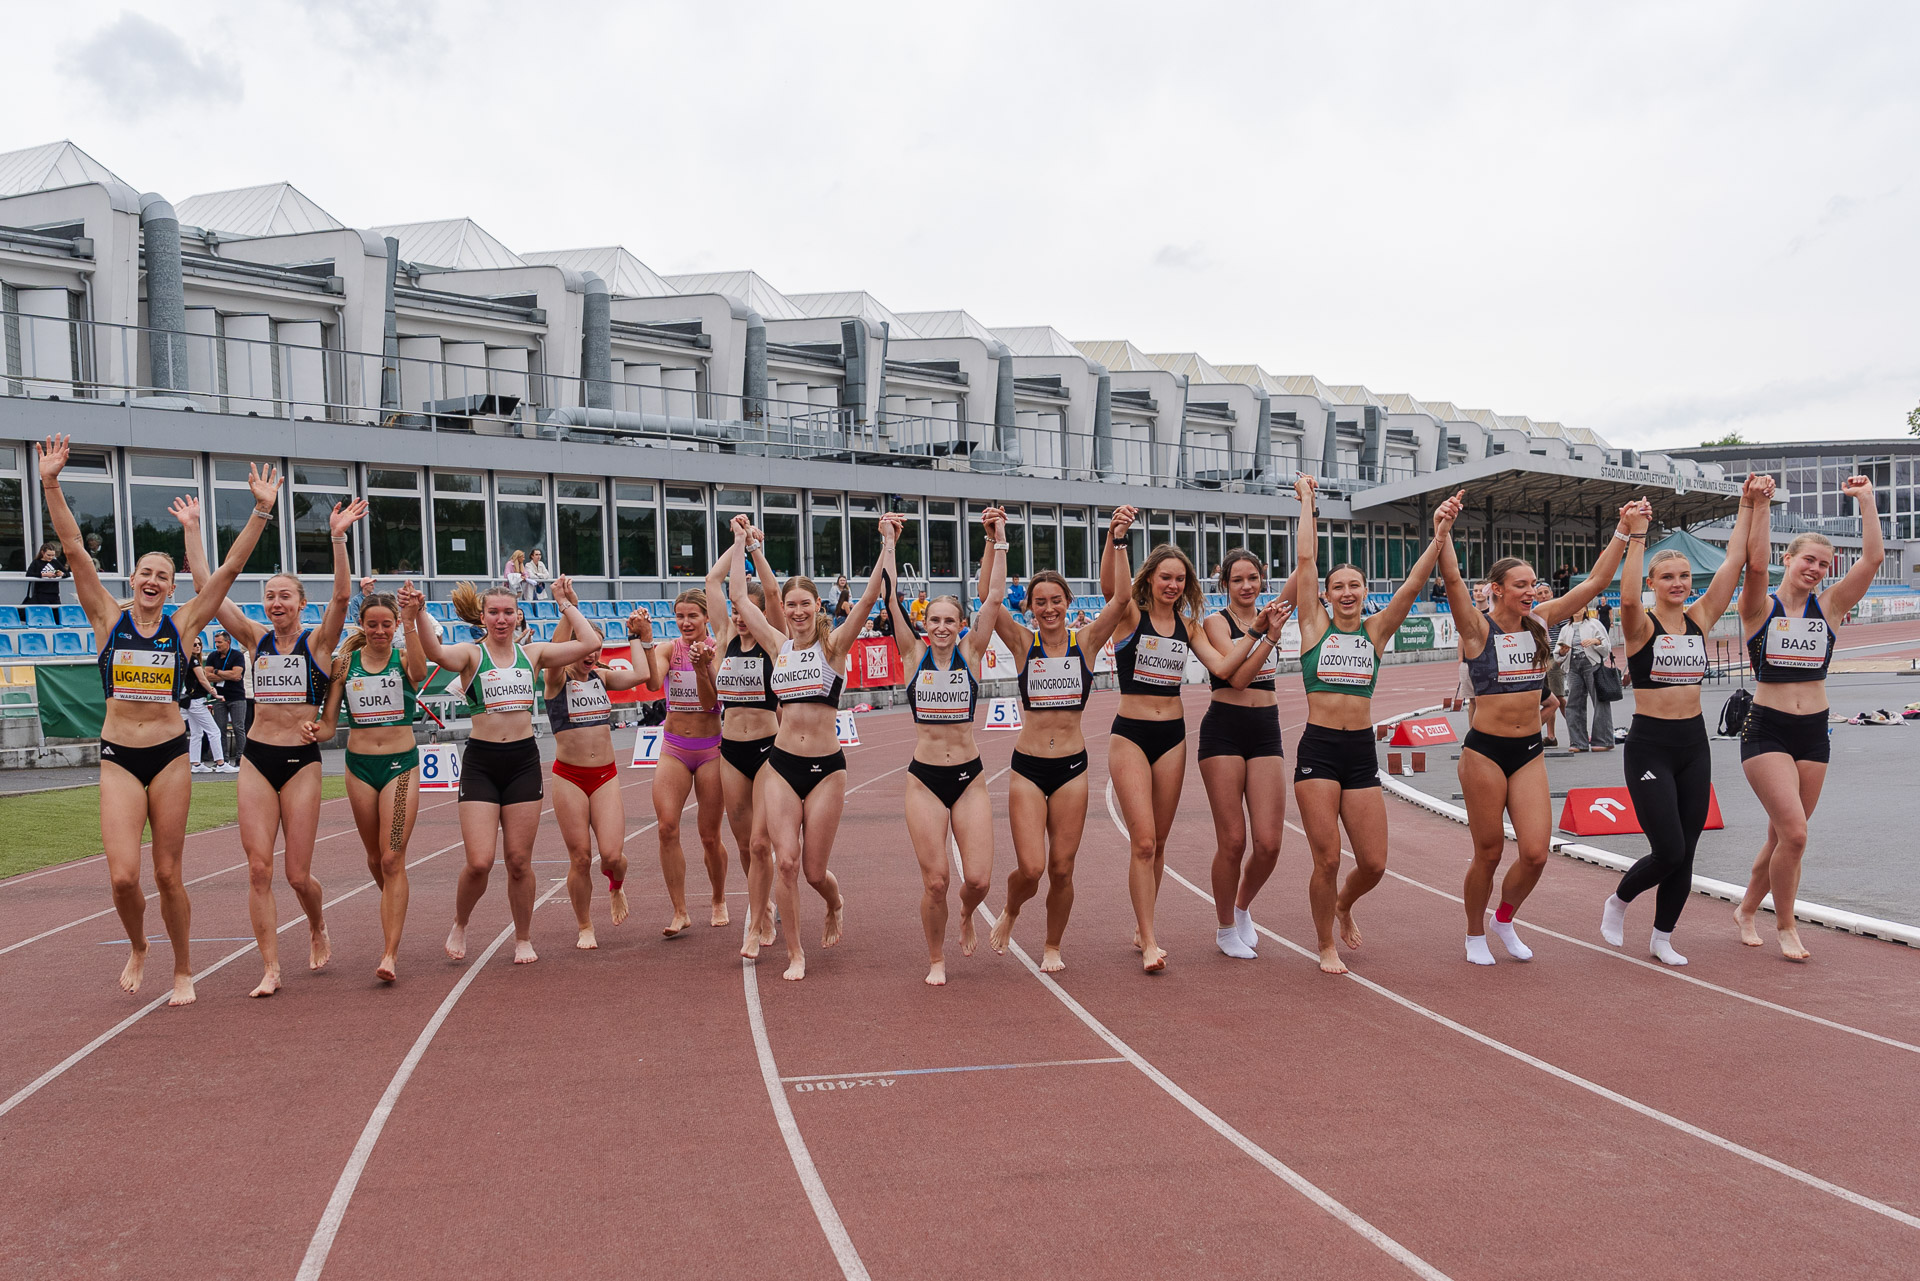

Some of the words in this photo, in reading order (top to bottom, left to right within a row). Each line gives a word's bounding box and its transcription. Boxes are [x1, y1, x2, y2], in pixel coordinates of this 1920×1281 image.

[1601, 466, 1626, 480] STADION
[1626, 470, 1674, 486] LEKKOATLETYCZNY
[1694, 480, 1718, 490] ZYGMUNTA
[1808, 622, 1823, 632] 23
[1170, 642, 1184, 654] 22
[1354, 638, 1368, 648] 14
[1688, 638, 1694, 648] 5
[1781, 638, 1816, 650] BAAS
[152, 654, 168, 666] 27
[284, 658, 300, 668] 24
[800, 652, 815, 662] 29
[1138, 654, 1184, 672] RACZKOWSKA
[1320, 654, 1372, 668] LOZOVYTSKA
[1509, 652, 1534, 664] KUB
[1656, 656, 1704, 666] NOWICKA
[744, 660, 756, 669] 13
[1064, 660, 1070, 670] 6
[115, 670, 172, 684] LIGARSKA
[257, 676, 302, 686] BIELSKA
[717, 674, 762, 686] PERZYŃSKA
[772, 668, 820, 684] KONIECZKO
[950, 672, 964, 684] 25
[1140, 676, 1166, 684] WARSZAWA
[380, 678, 396, 688] 16
[593, 682, 600, 690] 4
[1030, 677, 1080, 690] WINOGRODZKA
[484, 685, 532, 698] KUCHARSKA
[670, 688, 698, 698] SUŁEK-SCHU
[917, 690, 969, 702] BUJAROWICZ
[360, 695, 392, 707] SURA
[572, 695, 609, 708] NOWAK
[994, 704, 1005, 722] 5
[1012, 704, 1018, 720] 5
[1428, 726, 1448, 734] ORLEN
[642, 736, 658, 758] 7
[422, 754, 438, 778] 8
[450, 752, 459, 778] 8
